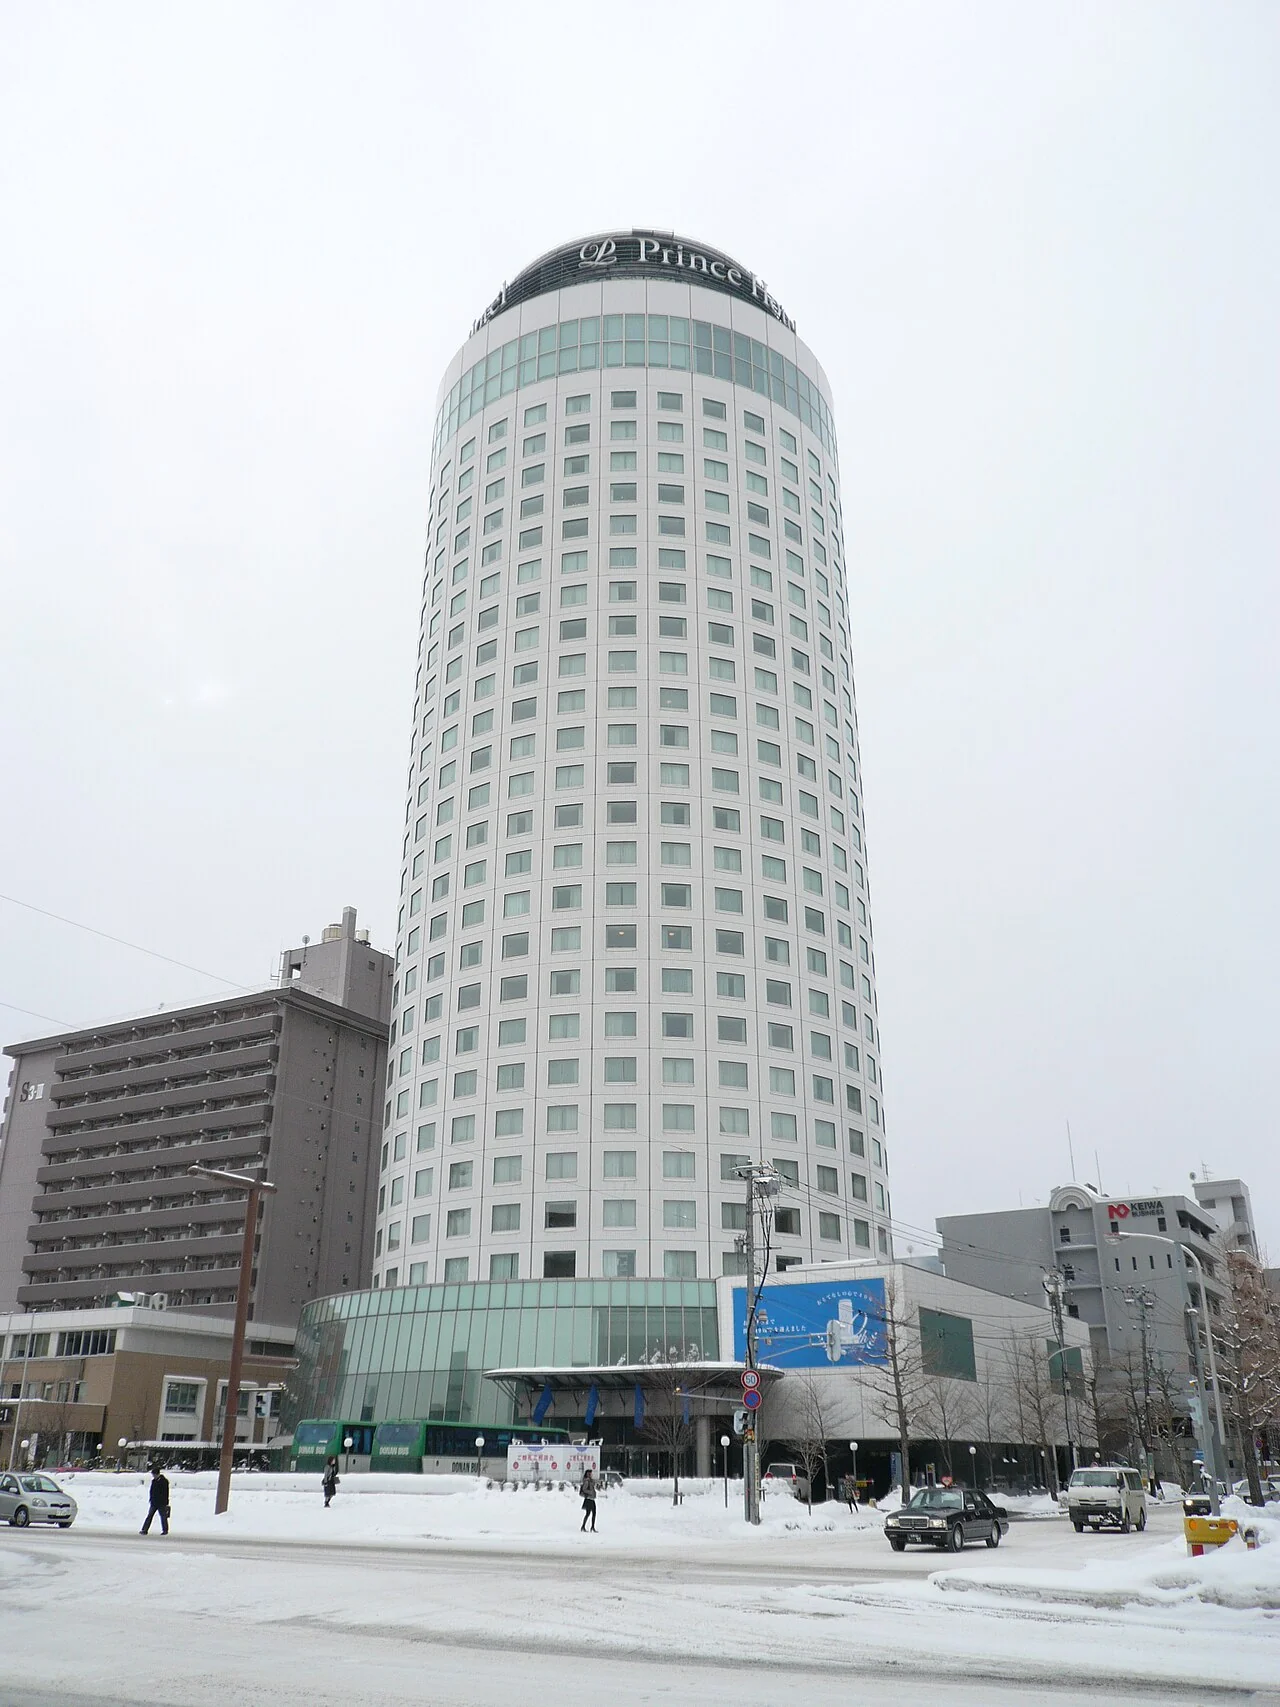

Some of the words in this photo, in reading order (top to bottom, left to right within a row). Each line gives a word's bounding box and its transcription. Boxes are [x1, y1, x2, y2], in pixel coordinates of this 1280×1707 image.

[638, 238, 742, 286] Prince
[1130, 1201, 1163, 1211] KEIWA
[1131, 1209, 1165, 1218] BUSINESS
[745, 1375, 756, 1384] 50
[315, 1446, 326, 1455] BUS
[379, 1446, 398, 1455] DONAN
[398, 1446, 409, 1455] BUS
[452, 1462, 470, 1473] DONAN
